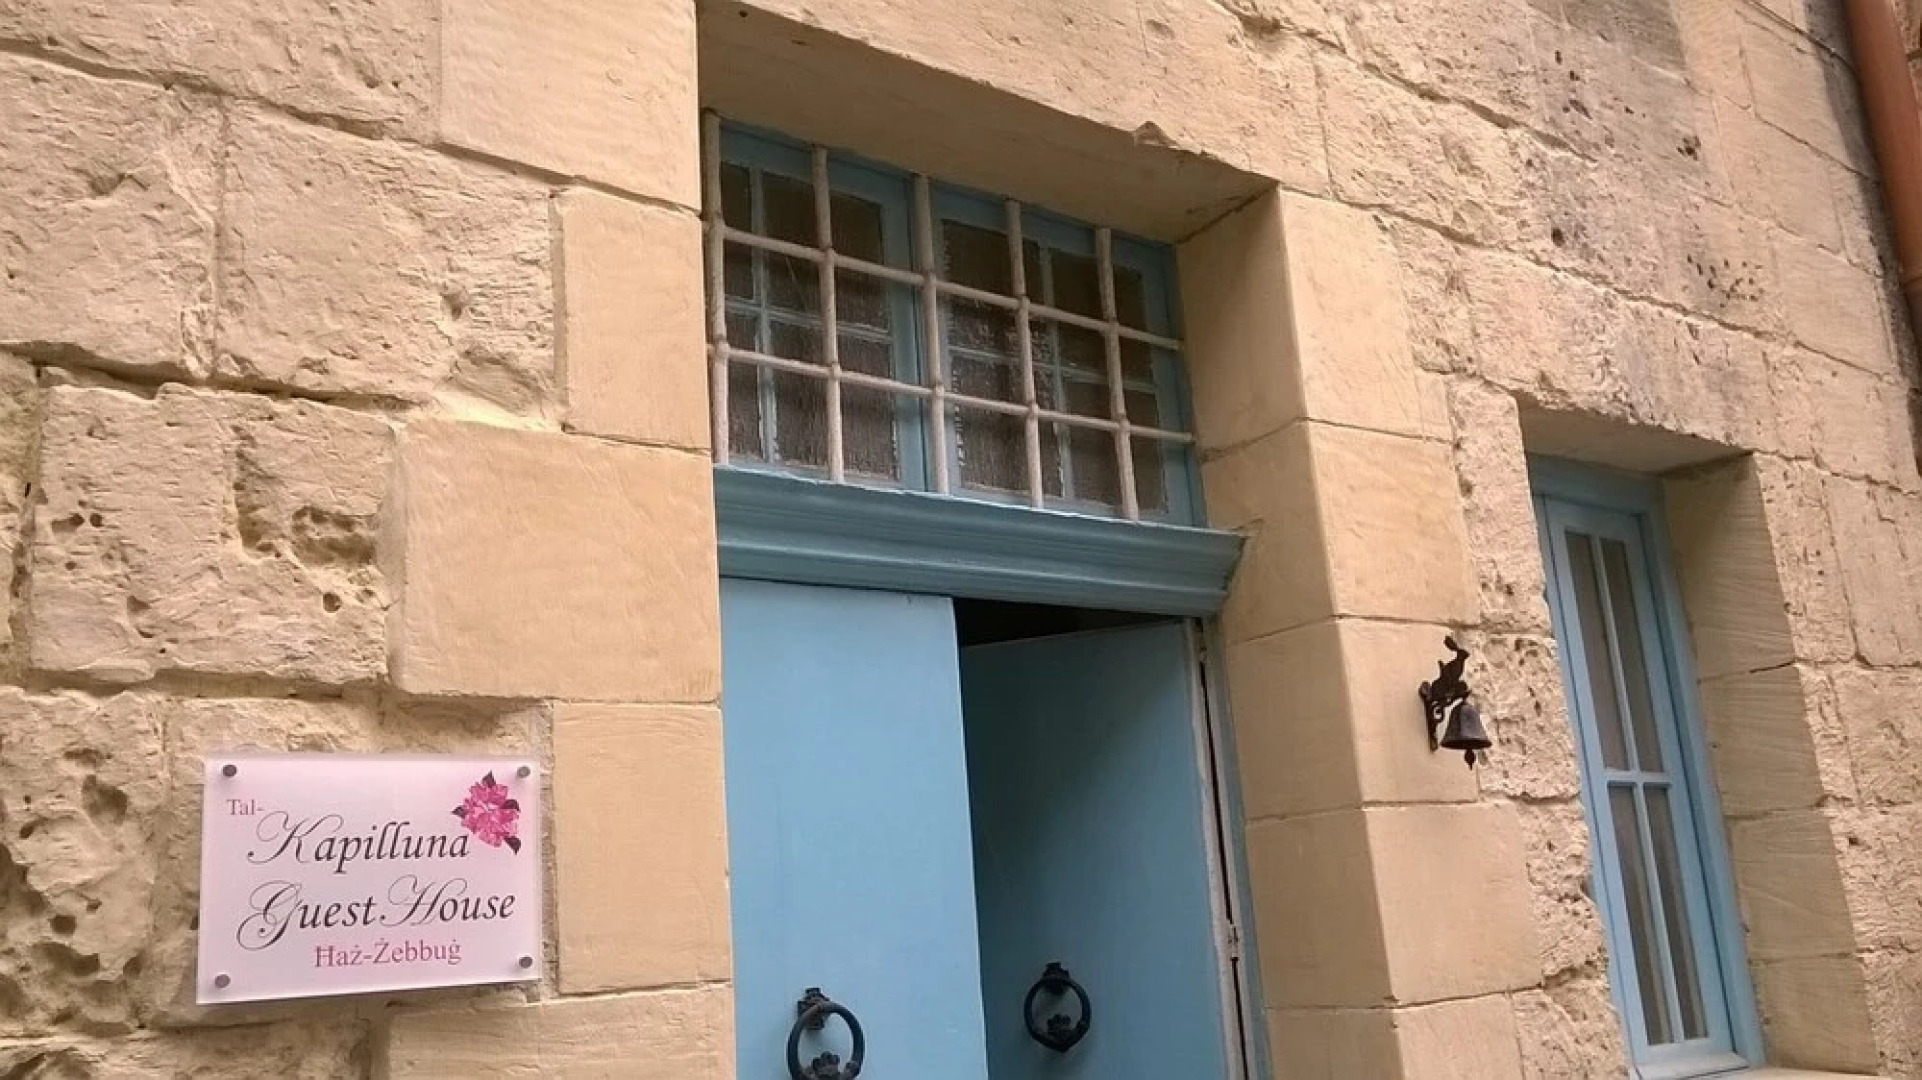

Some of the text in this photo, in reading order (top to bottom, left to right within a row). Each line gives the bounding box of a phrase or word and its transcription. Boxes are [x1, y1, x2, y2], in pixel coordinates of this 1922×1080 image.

[226, 798, 264, 816] Tal-
[247, 810, 470, 874] Kapilluna
[236, 874, 516, 950] Guest House
